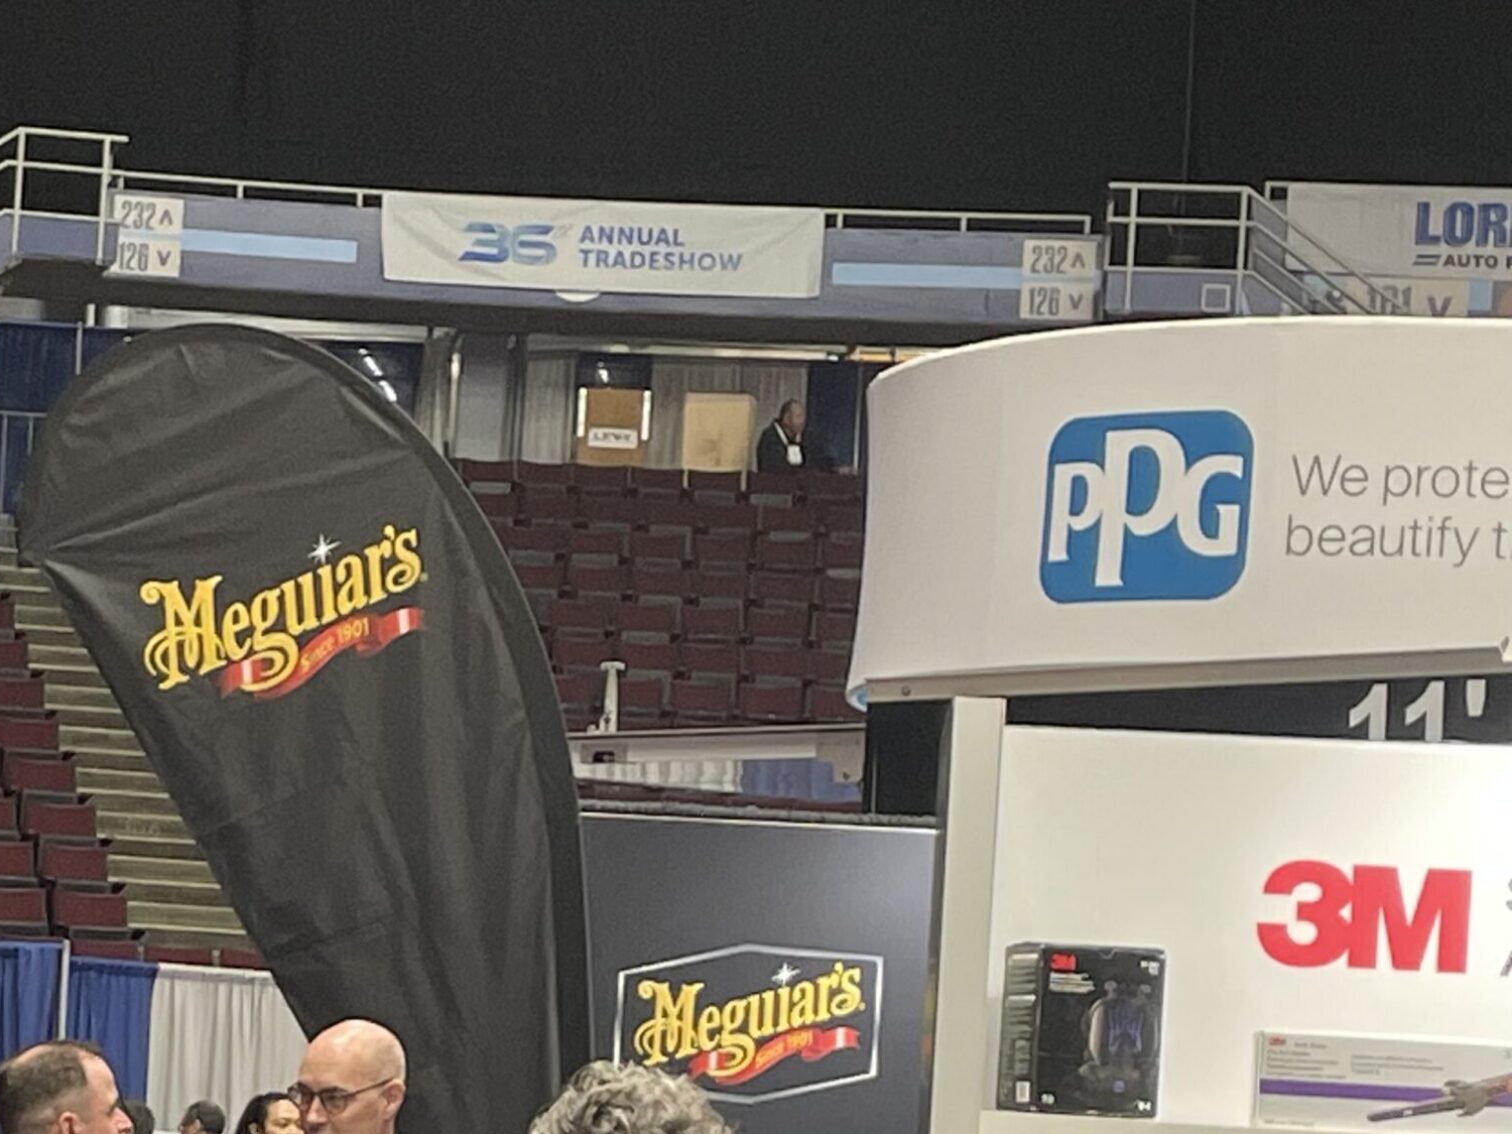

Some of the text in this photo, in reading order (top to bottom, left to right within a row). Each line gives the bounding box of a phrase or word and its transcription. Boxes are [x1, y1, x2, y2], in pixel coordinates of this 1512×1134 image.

[121, 200, 156, 230] 232
[579, 224, 686, 248] ANNUAL
[1414, 201, 1512, 248] LOR
[579, 248, 744, 272] TRADESHOW
[1030, 245, 1068, 275] 232
[1443, 254, 1499, 269] AUTO
[1292, 454, 1510, 506] We prote
[1046, 428, 1245, 588] PPG
[1286, 514, 1512, 568] beautify t
[140, 524, 423, 691] Meguiar's
[1256, 860, 1473, 975] 3M
[634, 962, 862, 1078] Meguiar's
